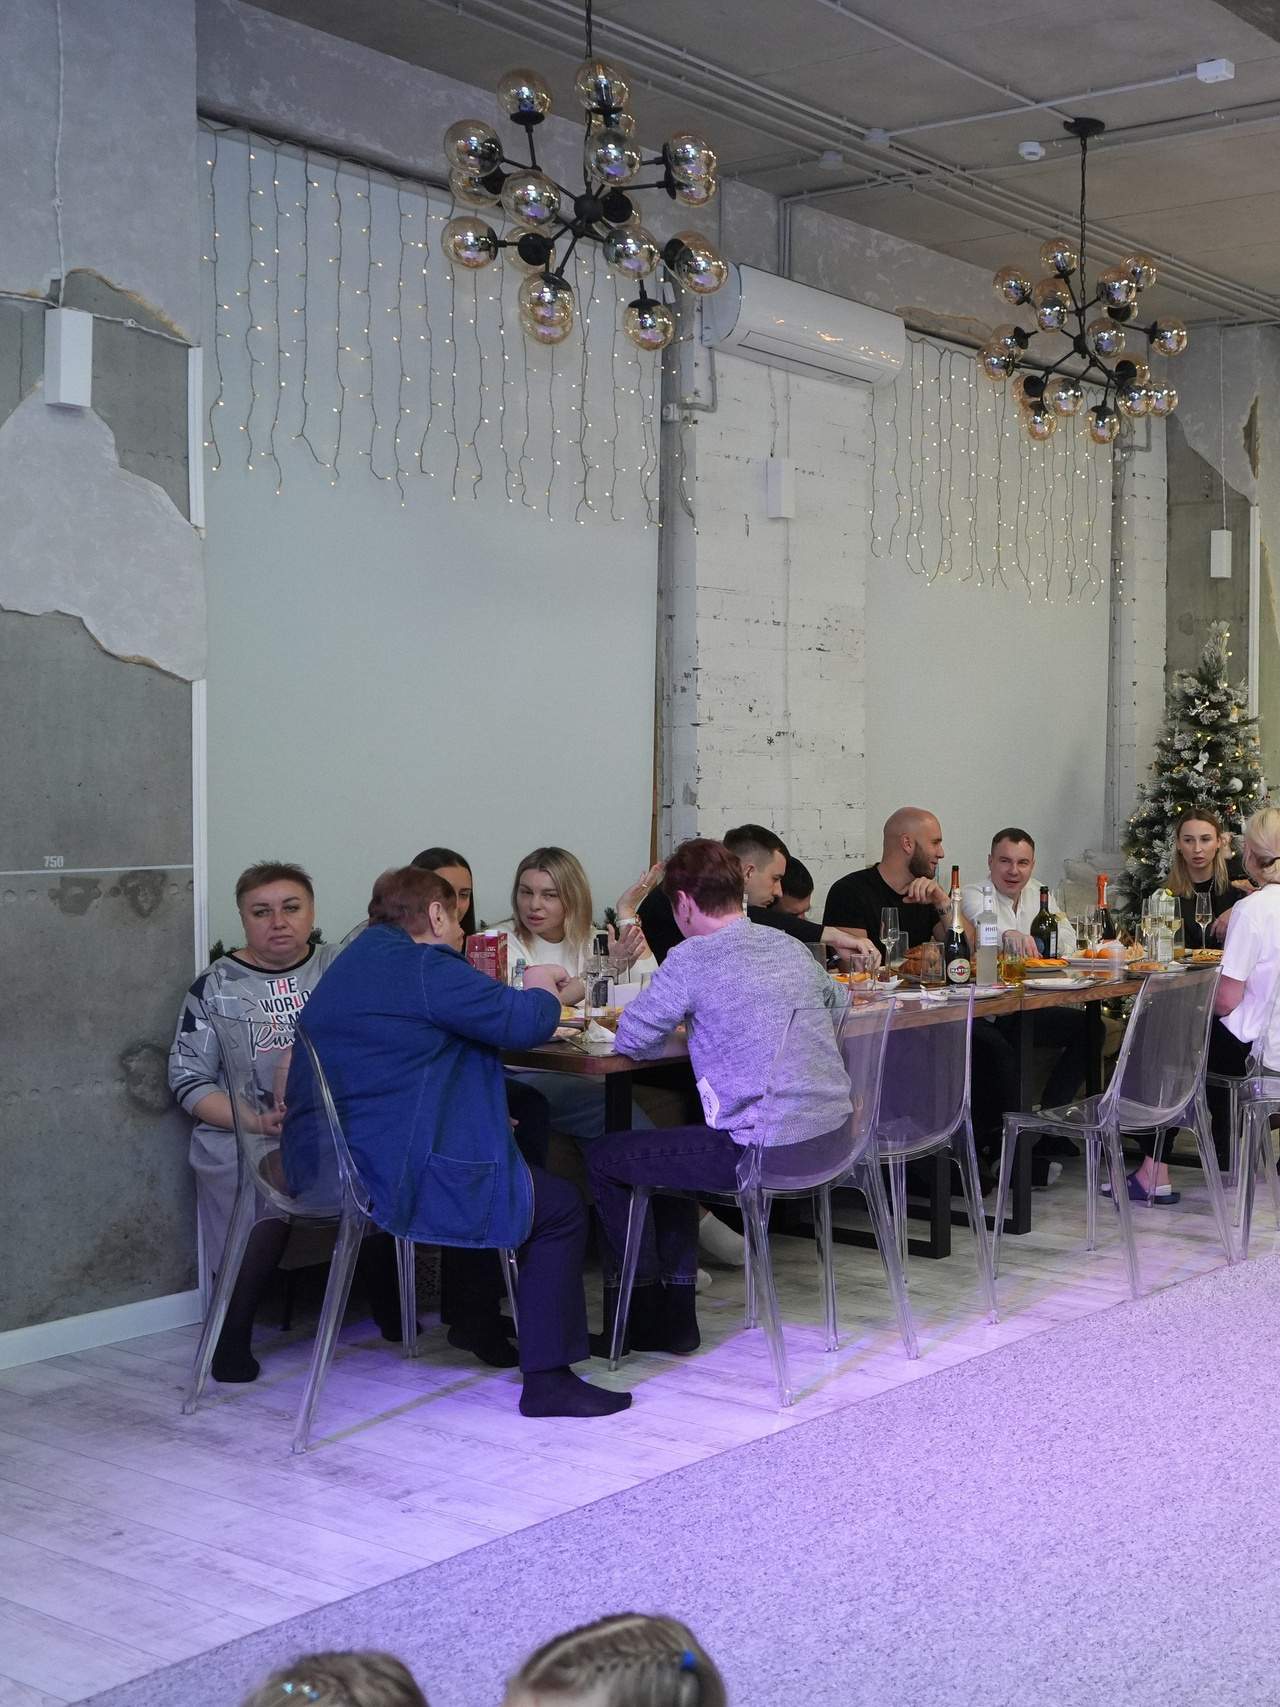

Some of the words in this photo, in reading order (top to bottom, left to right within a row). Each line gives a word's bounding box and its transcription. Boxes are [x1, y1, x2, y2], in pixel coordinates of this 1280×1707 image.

[43, 855, 64, 868] 750
[267, 977, 297, 996] THE
[260, 990, 310, 1013] WORLD
[271, 1015, 285, 1031] IS
[248, 1017, 295, 1058] Run
